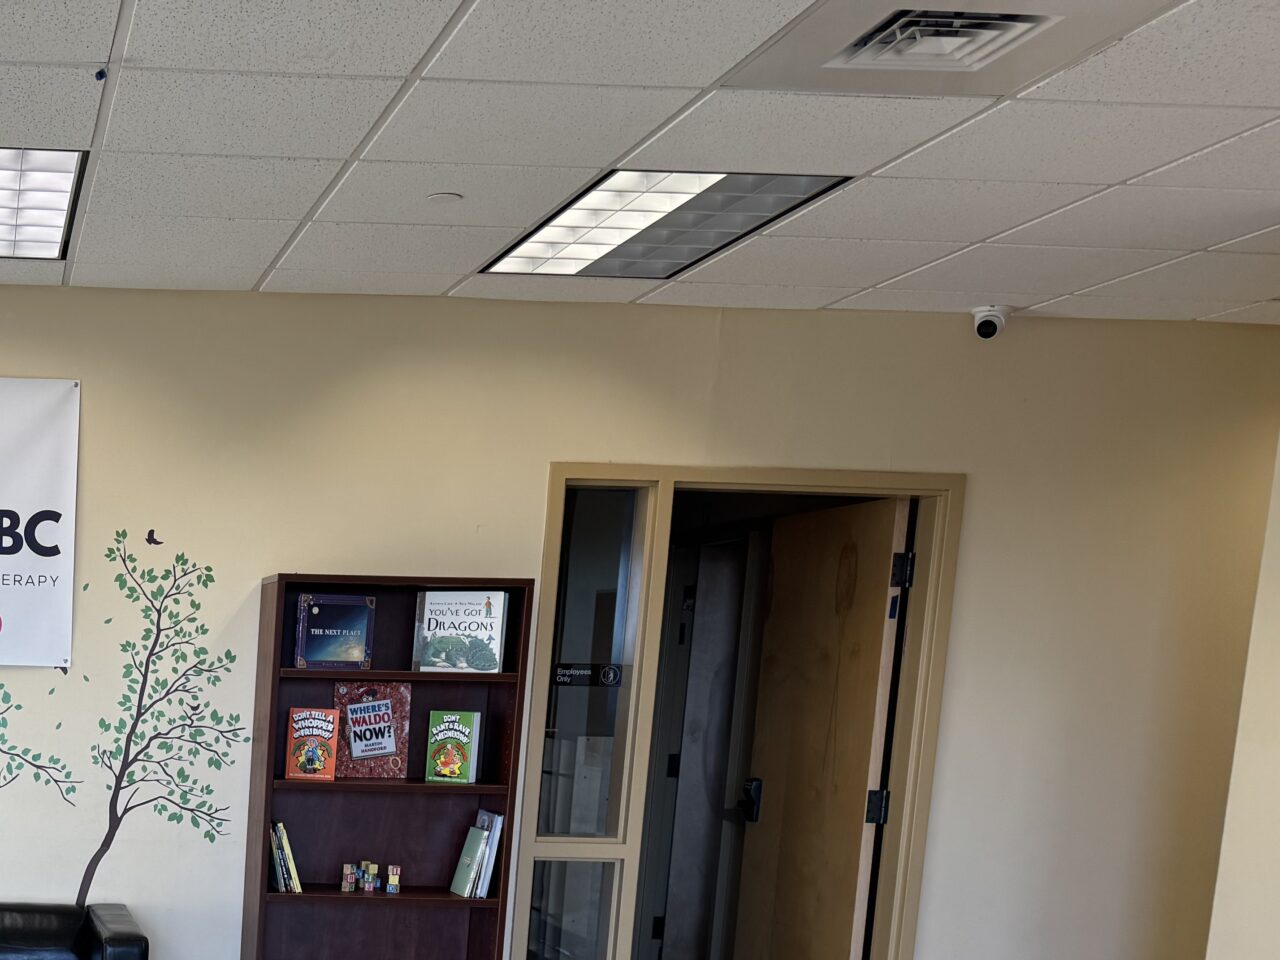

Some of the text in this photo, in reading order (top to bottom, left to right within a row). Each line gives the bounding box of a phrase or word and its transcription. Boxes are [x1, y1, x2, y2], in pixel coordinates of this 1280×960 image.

[429, 607, 483, 617] YOU'VE GOT
[427, 617, 495, 632] DRAGONS
[557, 667, 592, 676] Employees
[556, 675, 571, 683] Only
[311, 710, 326, 720] TELL
[327, 714, 334, 722] A
[349, 702, 390, 716] WHERE'S
[292, 718, 334, 732] WHOPPER
[350, 711, 391, 728] WALDO
[443, 714, 460, 722] DON'T
[352, 725, 392, 743] NOW?
[432, 722, 449, 735] RANT
[454, 722, 471, 736] RAVE
